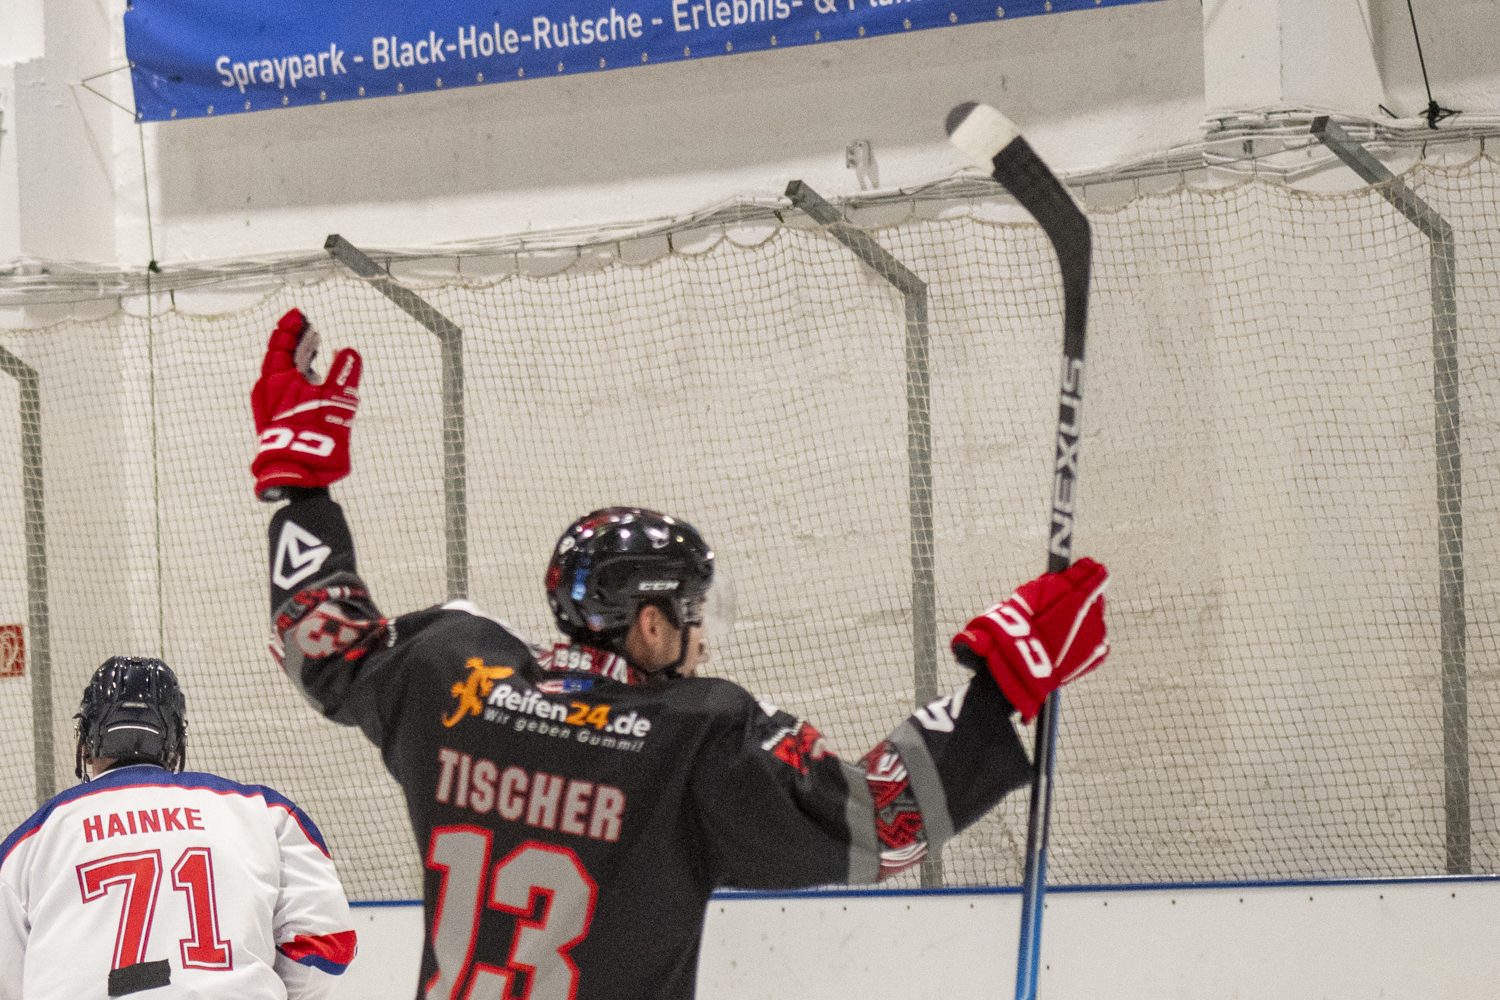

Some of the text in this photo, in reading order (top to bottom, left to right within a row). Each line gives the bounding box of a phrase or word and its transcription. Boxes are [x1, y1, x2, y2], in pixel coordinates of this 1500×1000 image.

[215, 42, 347, 93] Spraypark
[372, 7, 644, 71] Black-Hole-Rutsche
[1050, 356, 1084, 558] NEXUS
[483, 707, 509, 726] Wir
[514, 715, 572, 740] geben
[487, 683, 651, 738] Reifen24.de
[82, 806, 206, 843] HAINKE
[435, 747, 626, 843] TISCHER
[75, 846, 233, 973] 71
